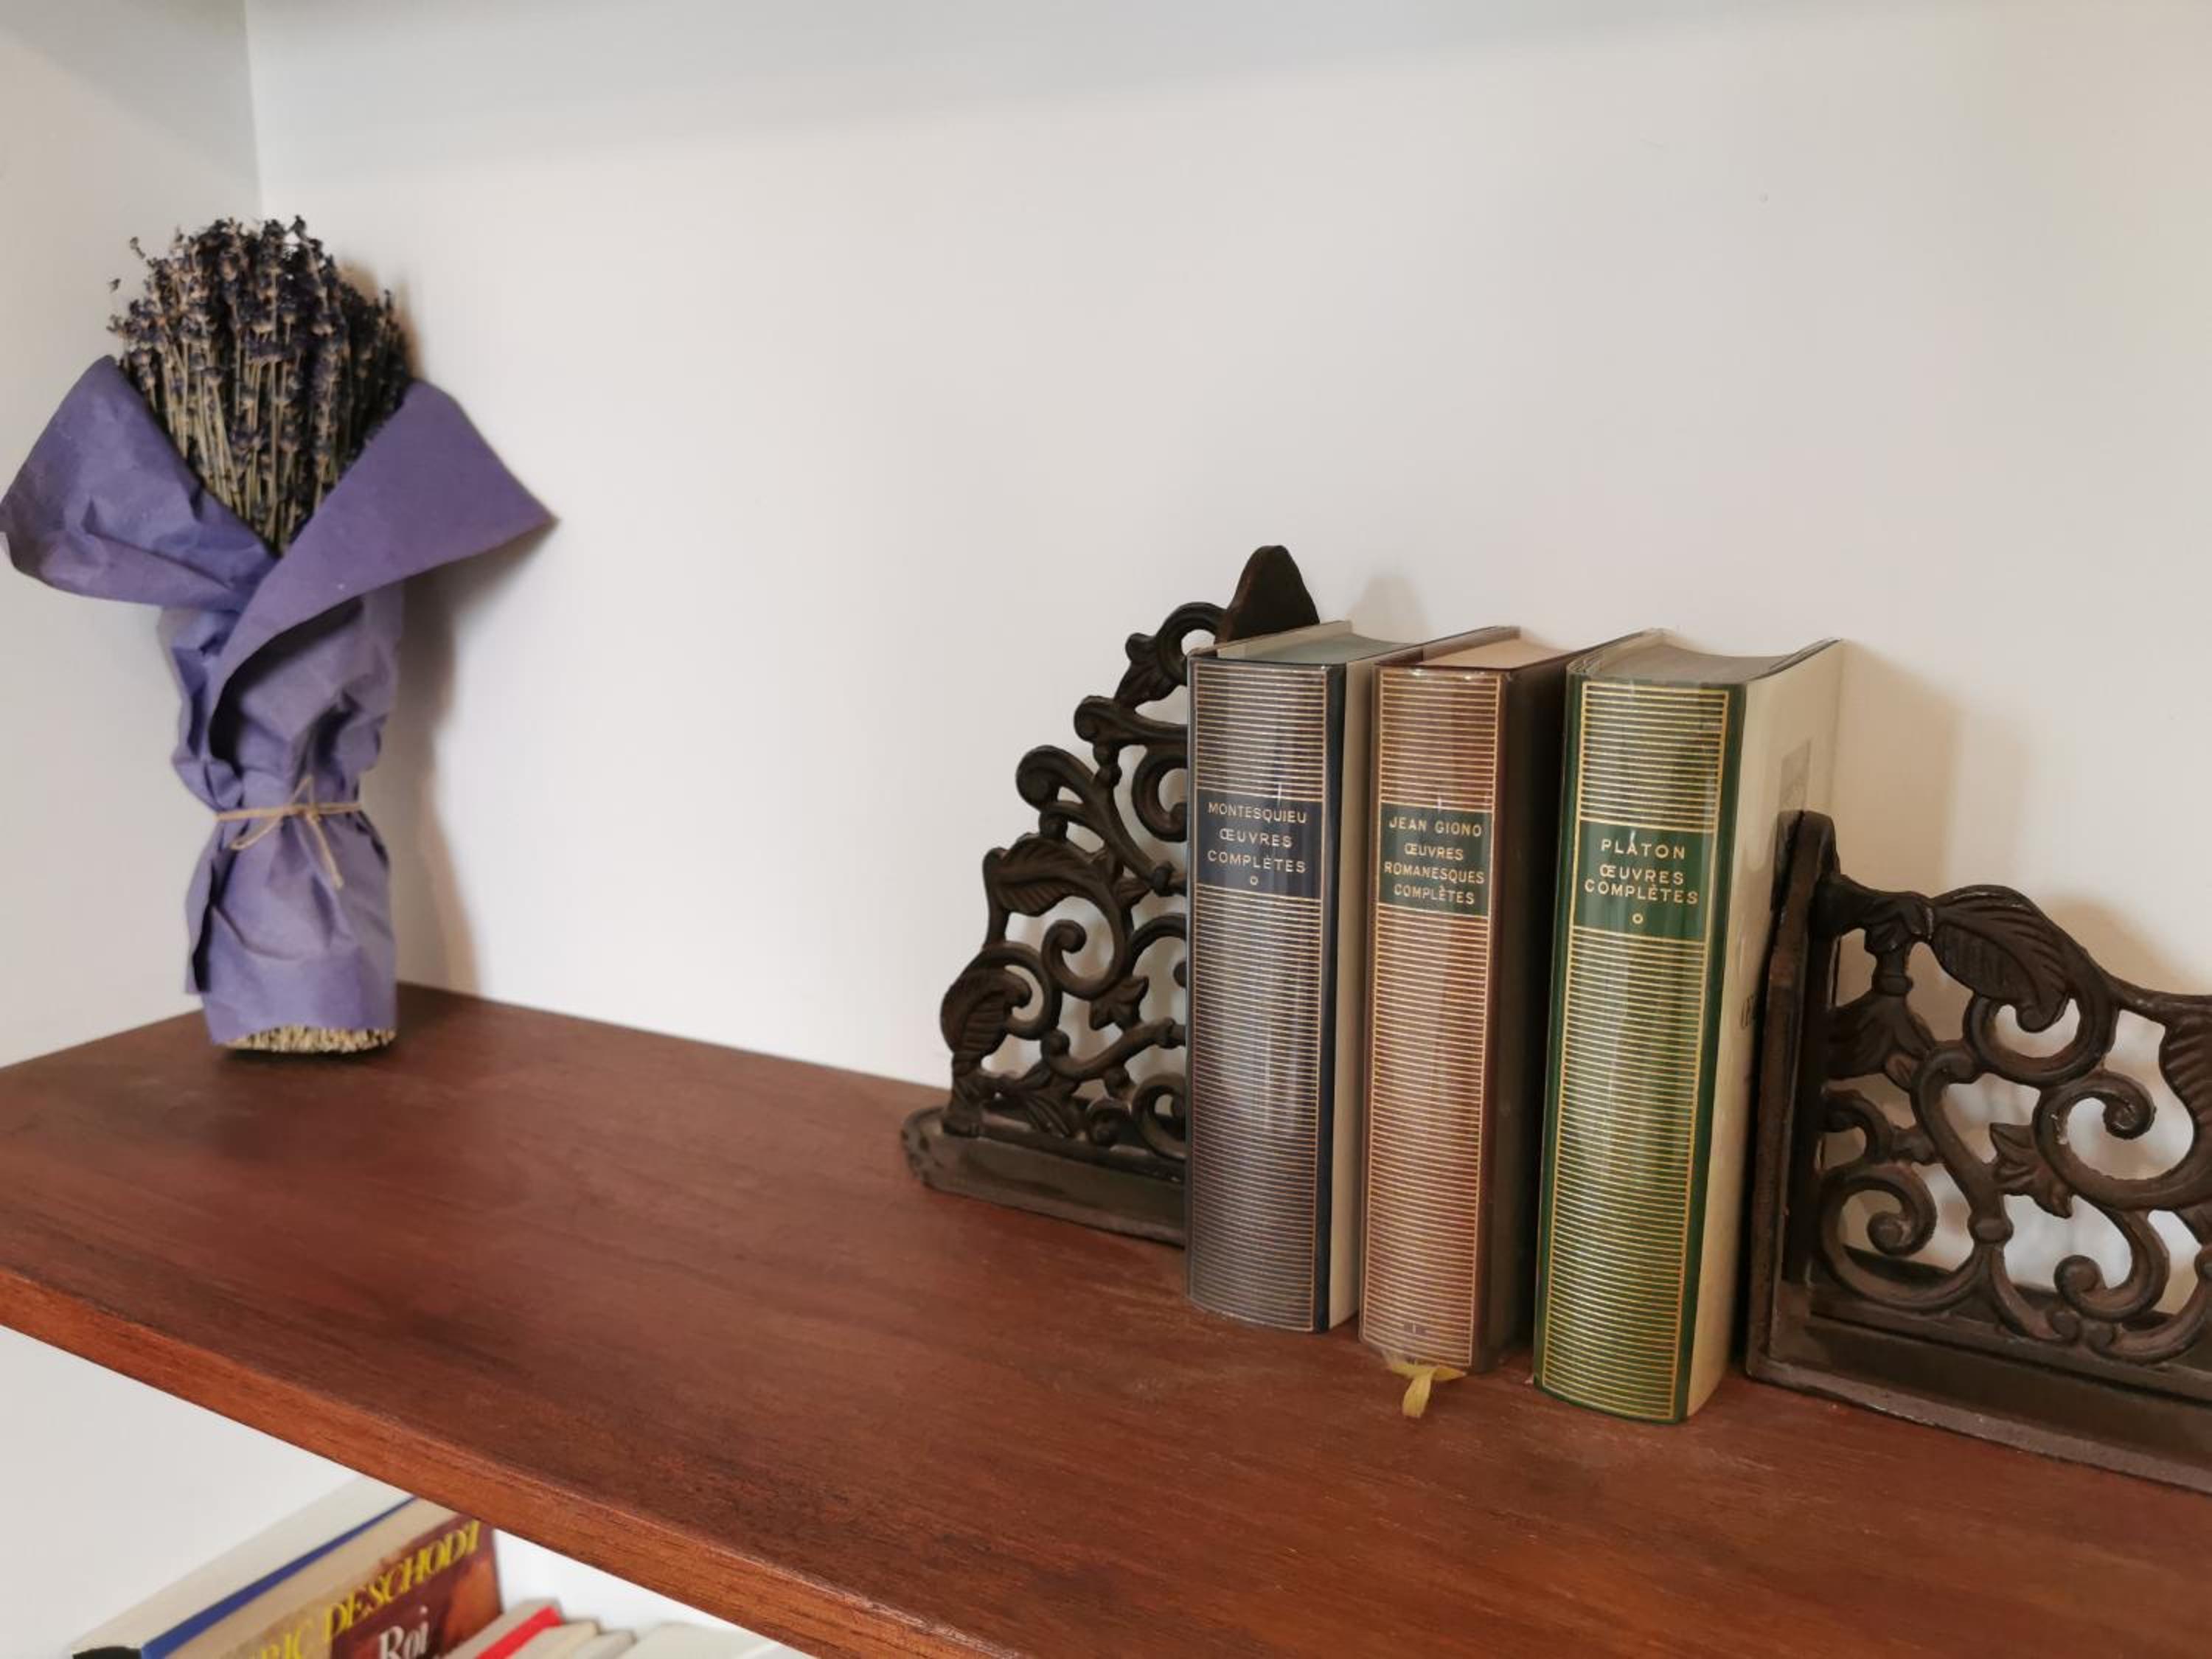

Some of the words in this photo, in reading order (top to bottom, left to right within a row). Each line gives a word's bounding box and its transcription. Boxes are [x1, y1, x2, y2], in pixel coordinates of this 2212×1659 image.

[1207, 801, 1307, 824] MONTESQUIEU
[1219, 827, 1293, 848] ŒUVRES
[1388, 816, 1427, 832] JEAN
[1435, 821, 1482, 838] GIONO
[1404, 843, 1464, 861] ŒUVRES
[1600, 838, 1686, 860] PLATON
[1383, 861, 1485, 885] ROMANESQUES
[1599, 863, 1685, 886] ŒUVRES
